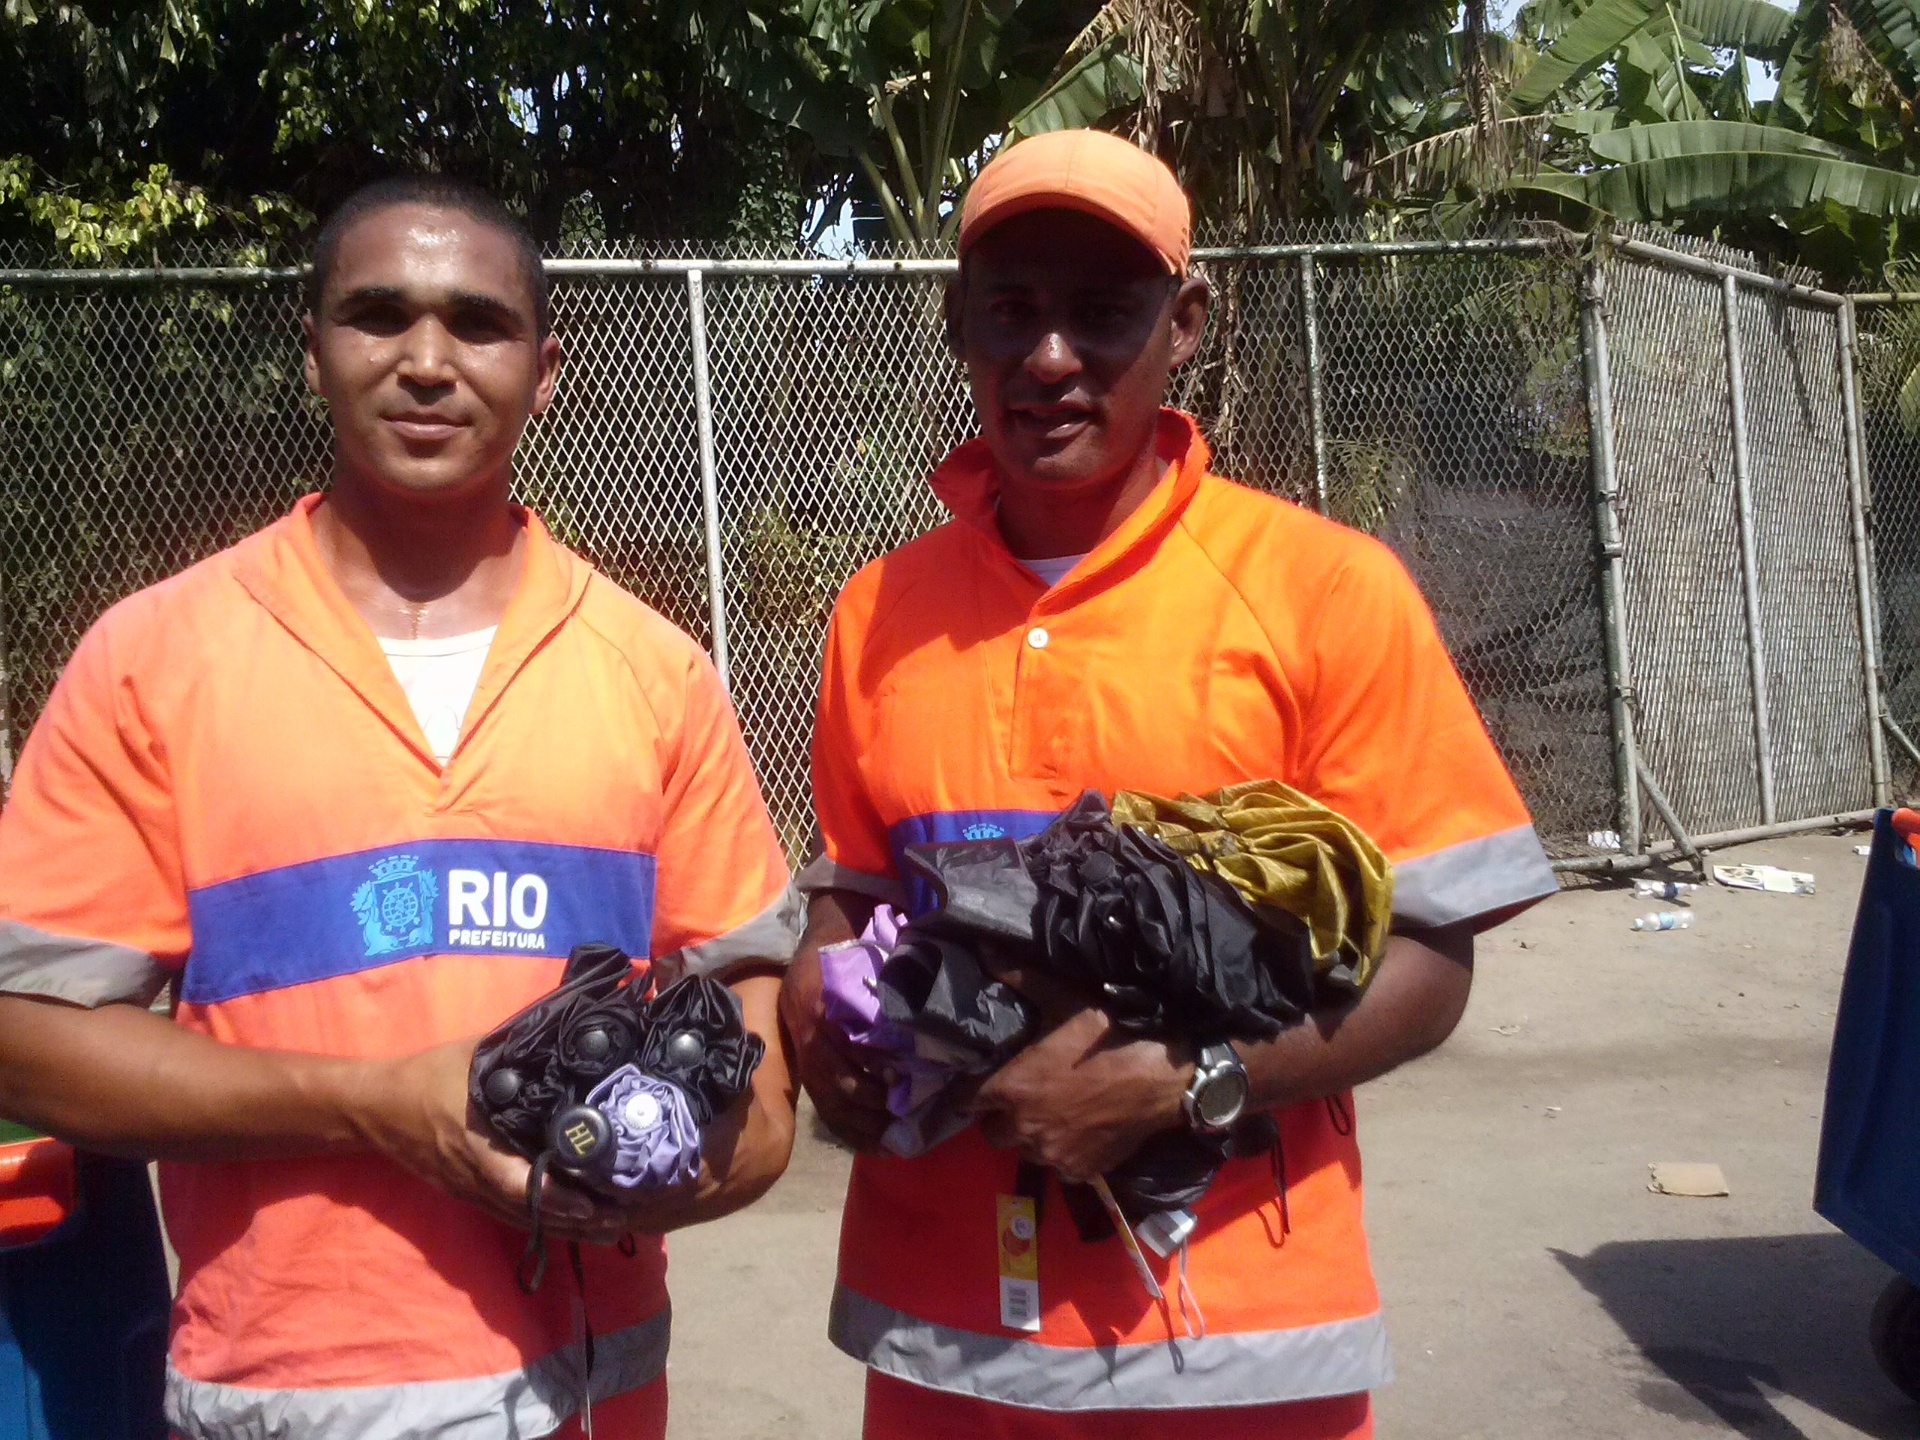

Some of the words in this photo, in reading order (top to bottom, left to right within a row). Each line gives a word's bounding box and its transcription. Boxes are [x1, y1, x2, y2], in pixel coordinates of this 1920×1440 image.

[449, 869, 548, 929] RIO
[449, 930, 546, 950] PREFEITURA
[565, 1121, 596, 1156] HL
